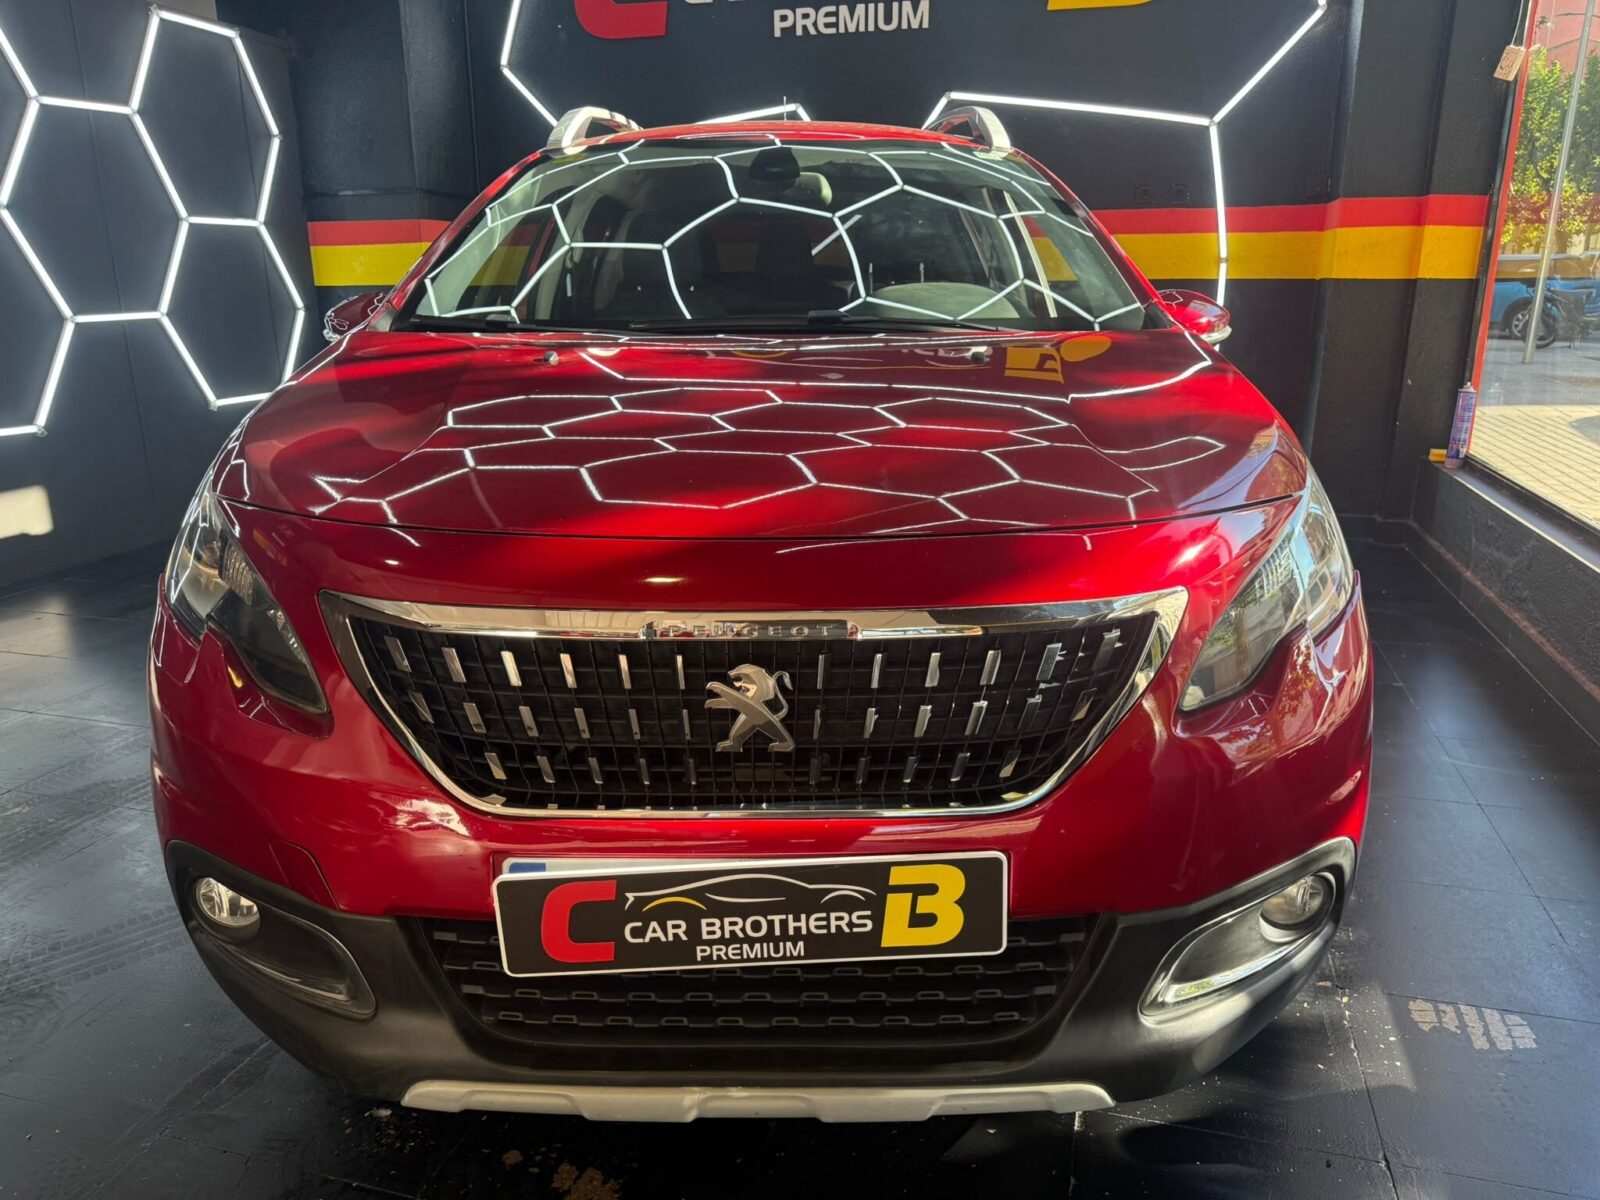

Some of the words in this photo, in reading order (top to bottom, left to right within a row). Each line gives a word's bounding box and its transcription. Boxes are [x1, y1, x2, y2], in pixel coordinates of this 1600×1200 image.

[773, 0, 930, 38] PREMIUM
[667, 623, 833, 638] PEUGEOT
[624, 920, 689, 943] CAR
[701, 910, 873, 940] BROTHERS
[696, 941, 805, 961] PREMIUM
